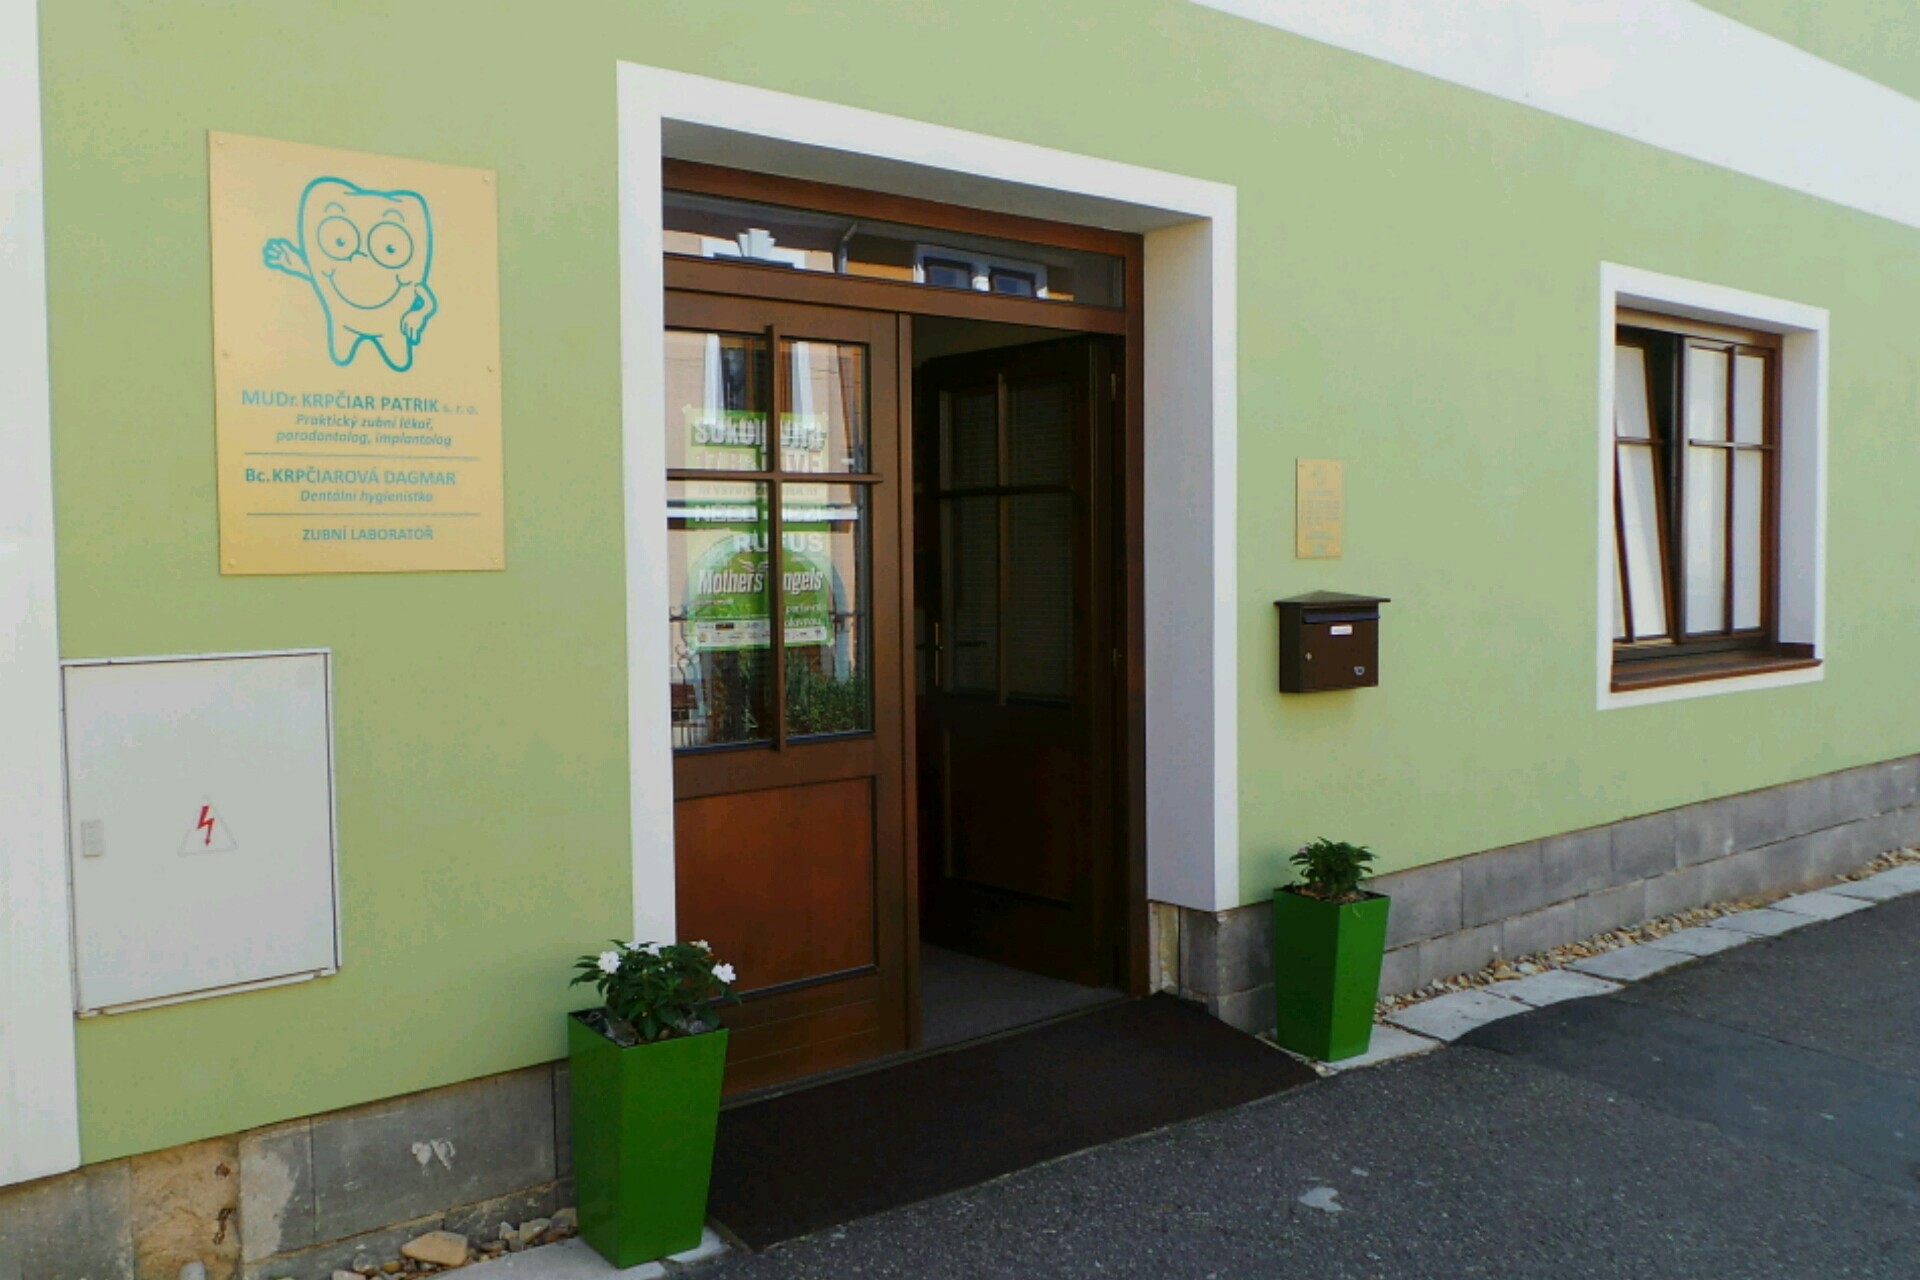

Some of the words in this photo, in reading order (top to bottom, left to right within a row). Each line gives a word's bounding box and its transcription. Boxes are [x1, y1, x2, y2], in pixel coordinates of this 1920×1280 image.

[242, 389, 297, 406] MUDr.
[302, 390, 375, 409] KRPČIAR
[380, 396, 439, 413] PATRIK
[296, 413, 357, 429] Praktický
[361, 415, 395, 429] zubní
[276, 430, 371, 445] parodontolog,
[375, 431, 452, 447] implantolog
[384, 471, 456, 486] DAGMAR
[300, 489, 357, 502] Dentální
[360, 490, 433, 504] hygienistka
[302, 525, 347, 541] ZUBNÍ
[351, 525, 434, 541] LABORATOŘ
